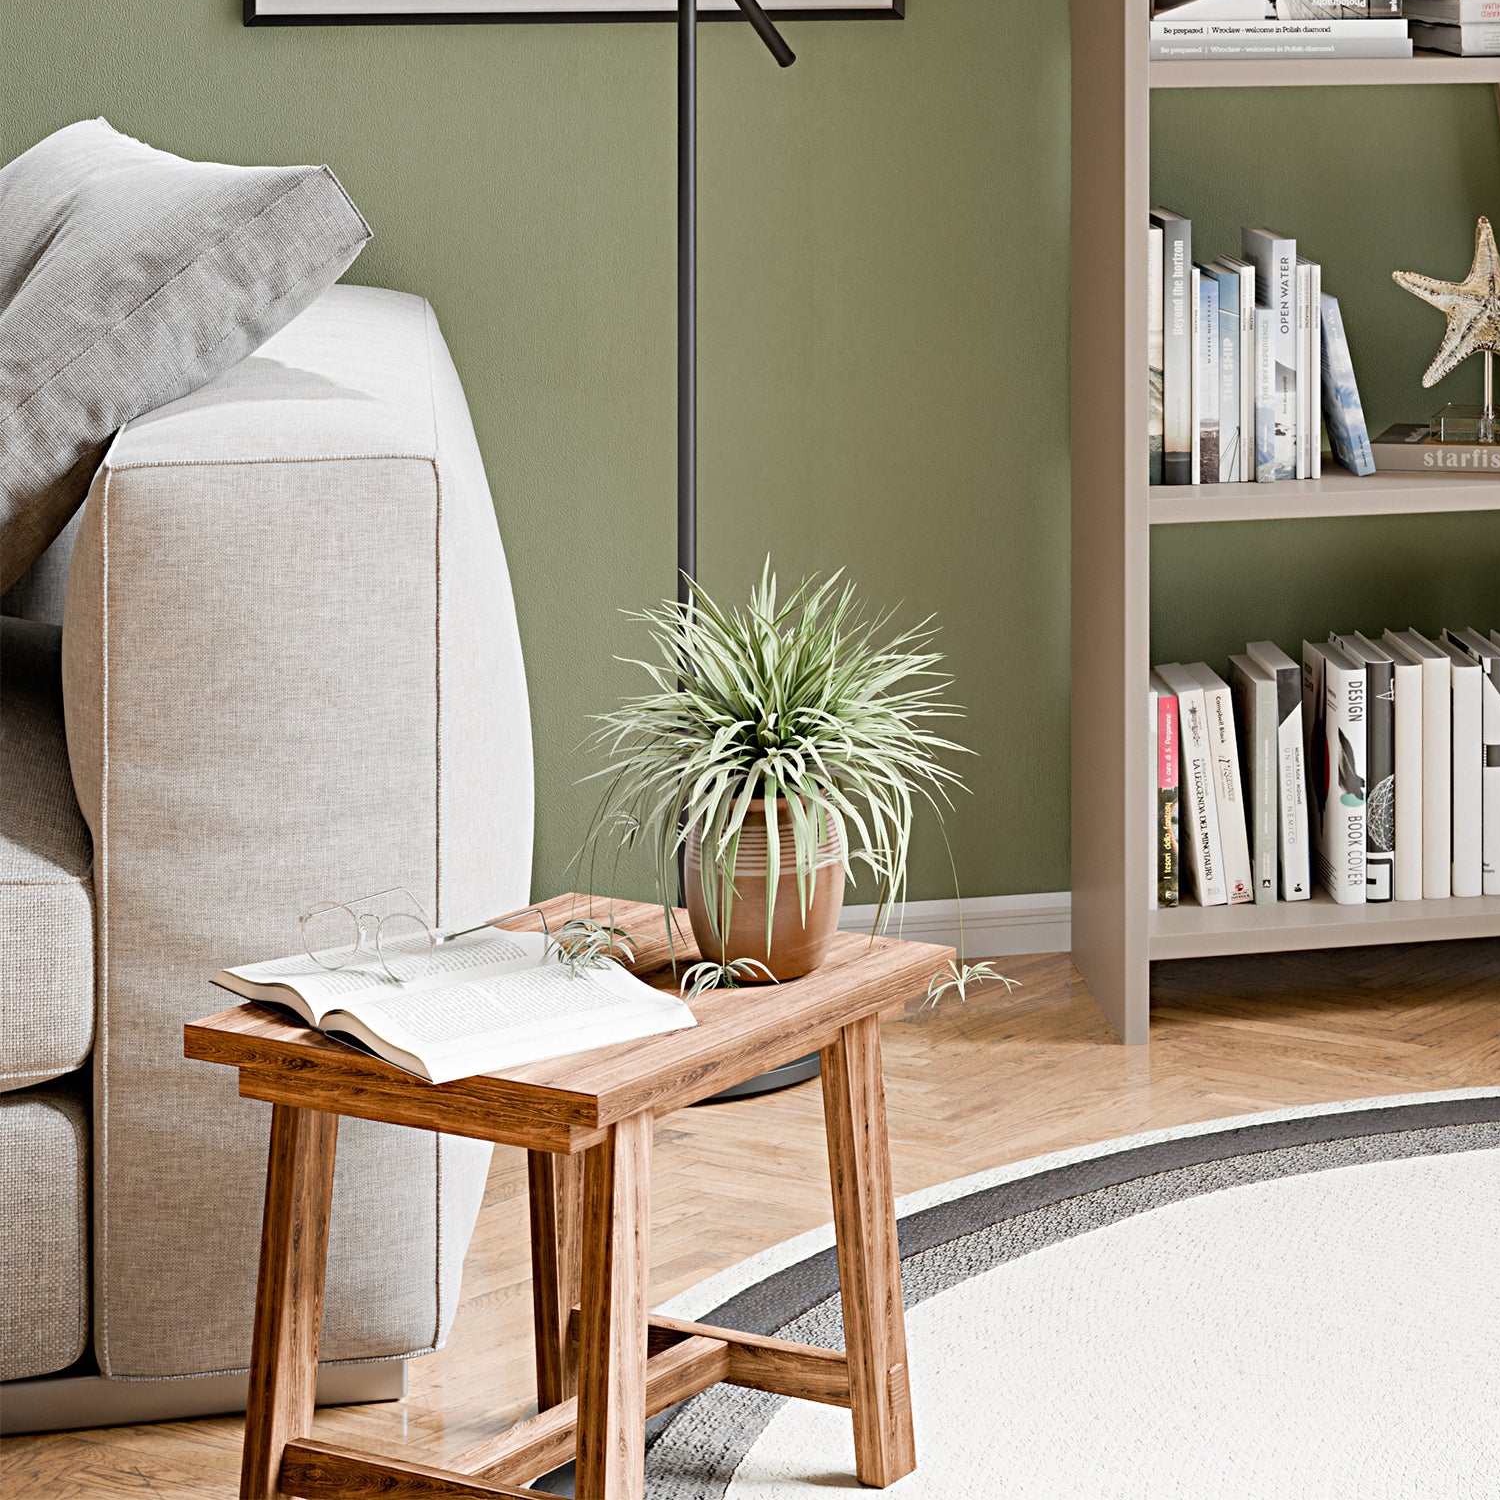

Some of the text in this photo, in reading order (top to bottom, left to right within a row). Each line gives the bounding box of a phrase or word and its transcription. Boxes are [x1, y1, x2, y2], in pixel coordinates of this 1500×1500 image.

[1173, 27, 1203, 35] prepared
[1172, 240, 1185, 336] Beyond the horizon
[1280, 257, 1290, 334] OPEN WATER
[1261, 319, 1270, 368] EXPERIENCE
[1223, 338, 1233, 403] THE SHIP
[1261, 385, 1270, 401] THE
[1215, 696, 1226, 744] Campbell Black
[1348, 681, 1363, 722] DESIGN
[1192, 759, 1200, 771] LA
[1284, 747, 1292, 761] UN
[1194, 772, 1205, 814] LEGGENDA
[1199, 816, 1207, 832] DEL
[1287, 806, 1296, 845] NEMICO
[1201, 832, 1213, 881] MINOTAURO
[1348, 815, 1363, 887] BOOK COVER
